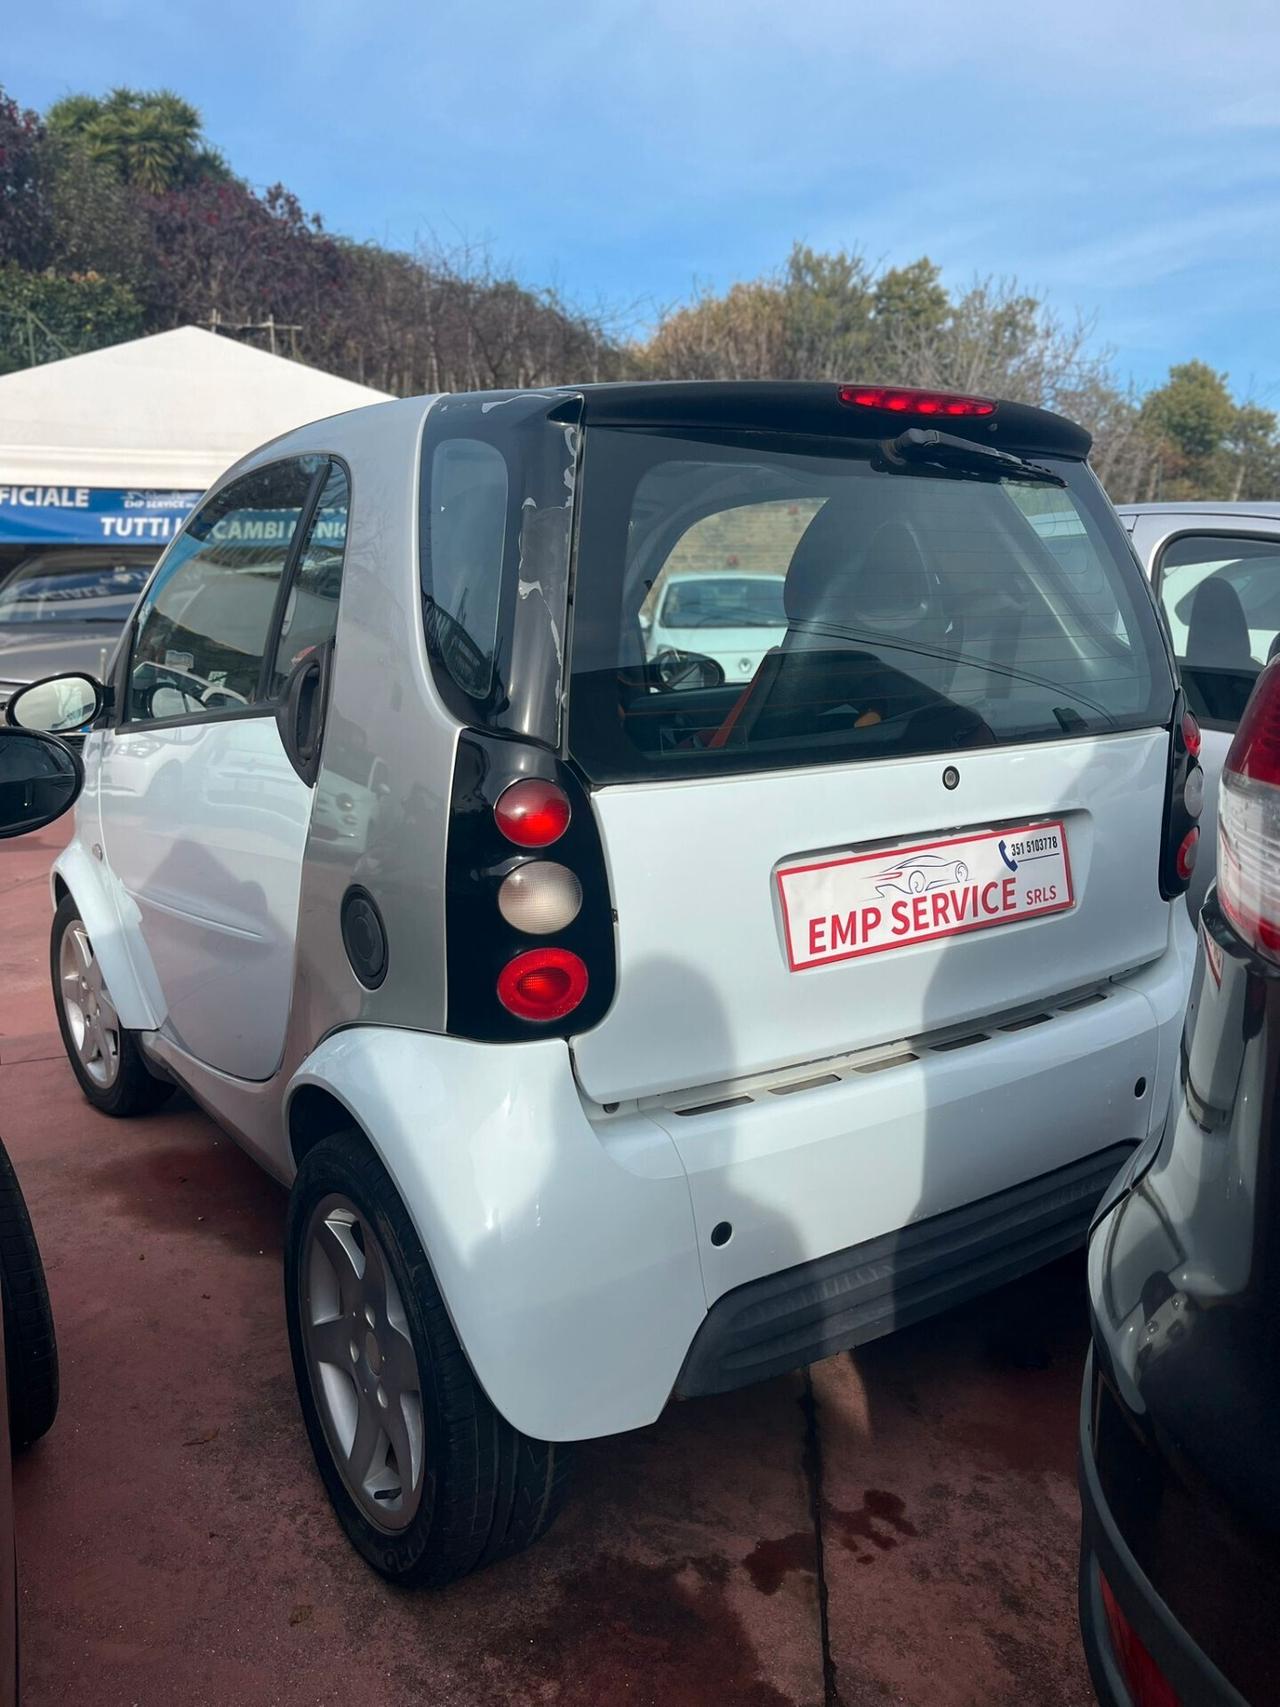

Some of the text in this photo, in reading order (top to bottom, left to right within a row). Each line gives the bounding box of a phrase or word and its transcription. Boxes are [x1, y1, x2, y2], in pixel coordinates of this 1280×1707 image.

[101, 517, 170, 536] TUTTI
[206, 519, 285, 539] CAMBI
[1011, 835, 1058, 857] 351 5103778
[809, 877, 1057, 955] EMP SERVICE SRLS
